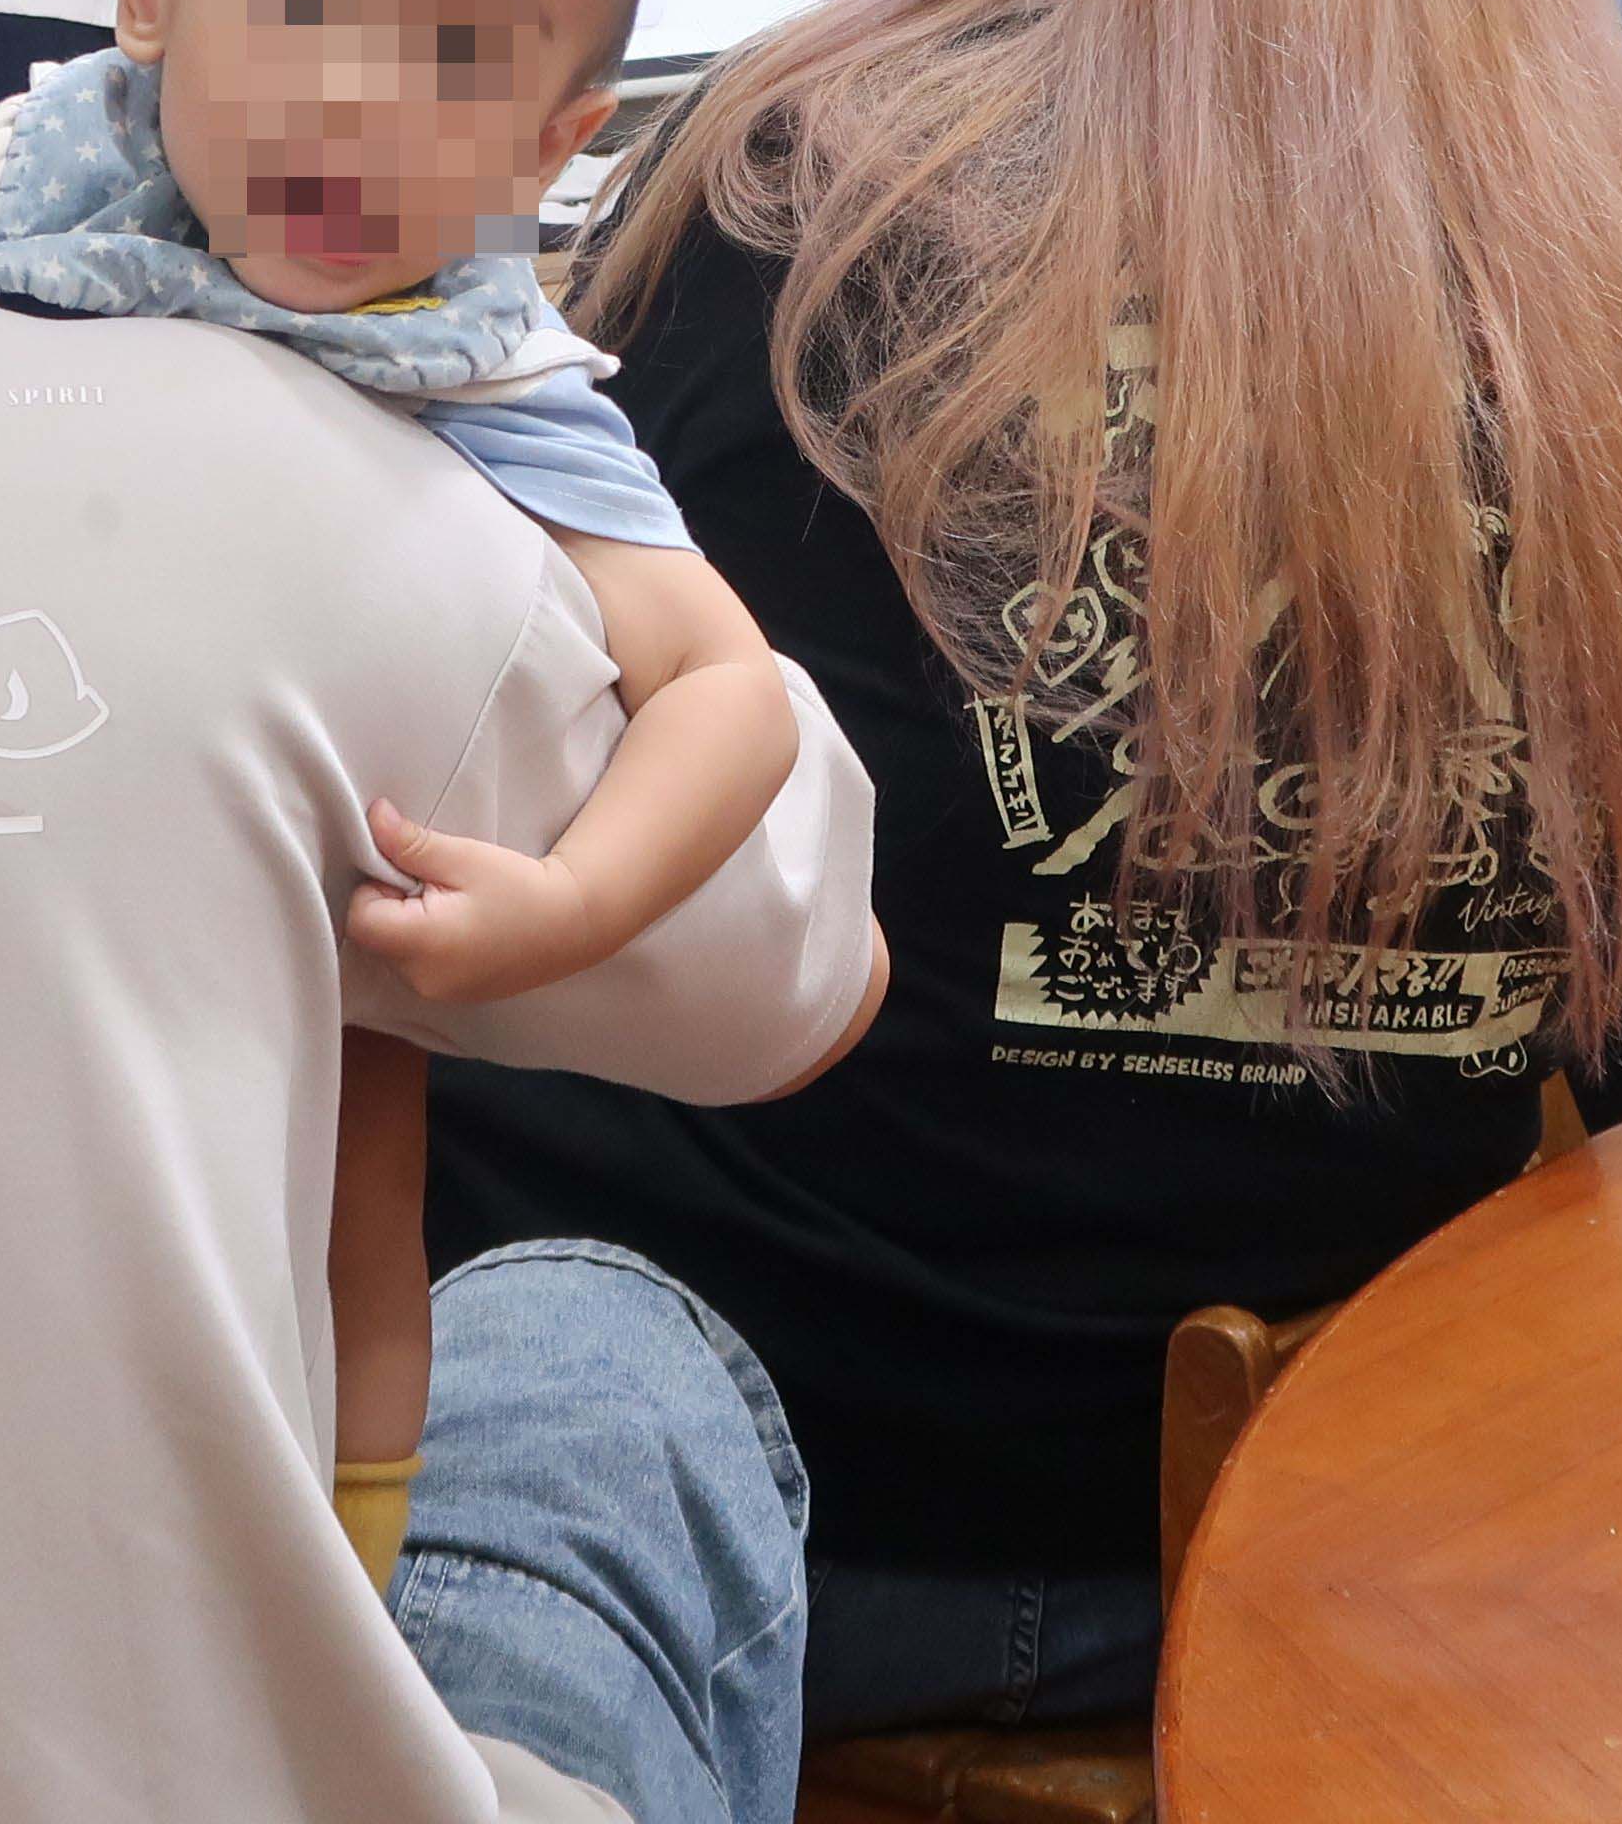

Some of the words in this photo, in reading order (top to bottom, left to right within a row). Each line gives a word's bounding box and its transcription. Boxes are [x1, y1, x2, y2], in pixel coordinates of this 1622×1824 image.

[7, 382, 107, 408] SPIRIT
[1069, 891, 1189, 934] あまして
[1307, 998, 1473, 1029] NSHAKABLE
[992, 1044, 1076, 1068] DESIGN
[1080, 1049, 1116, 1071] BY
[1122, 1054, 1234, 1083] SENSELESS
[1240, 1062, 1307, 1086] BRAND
